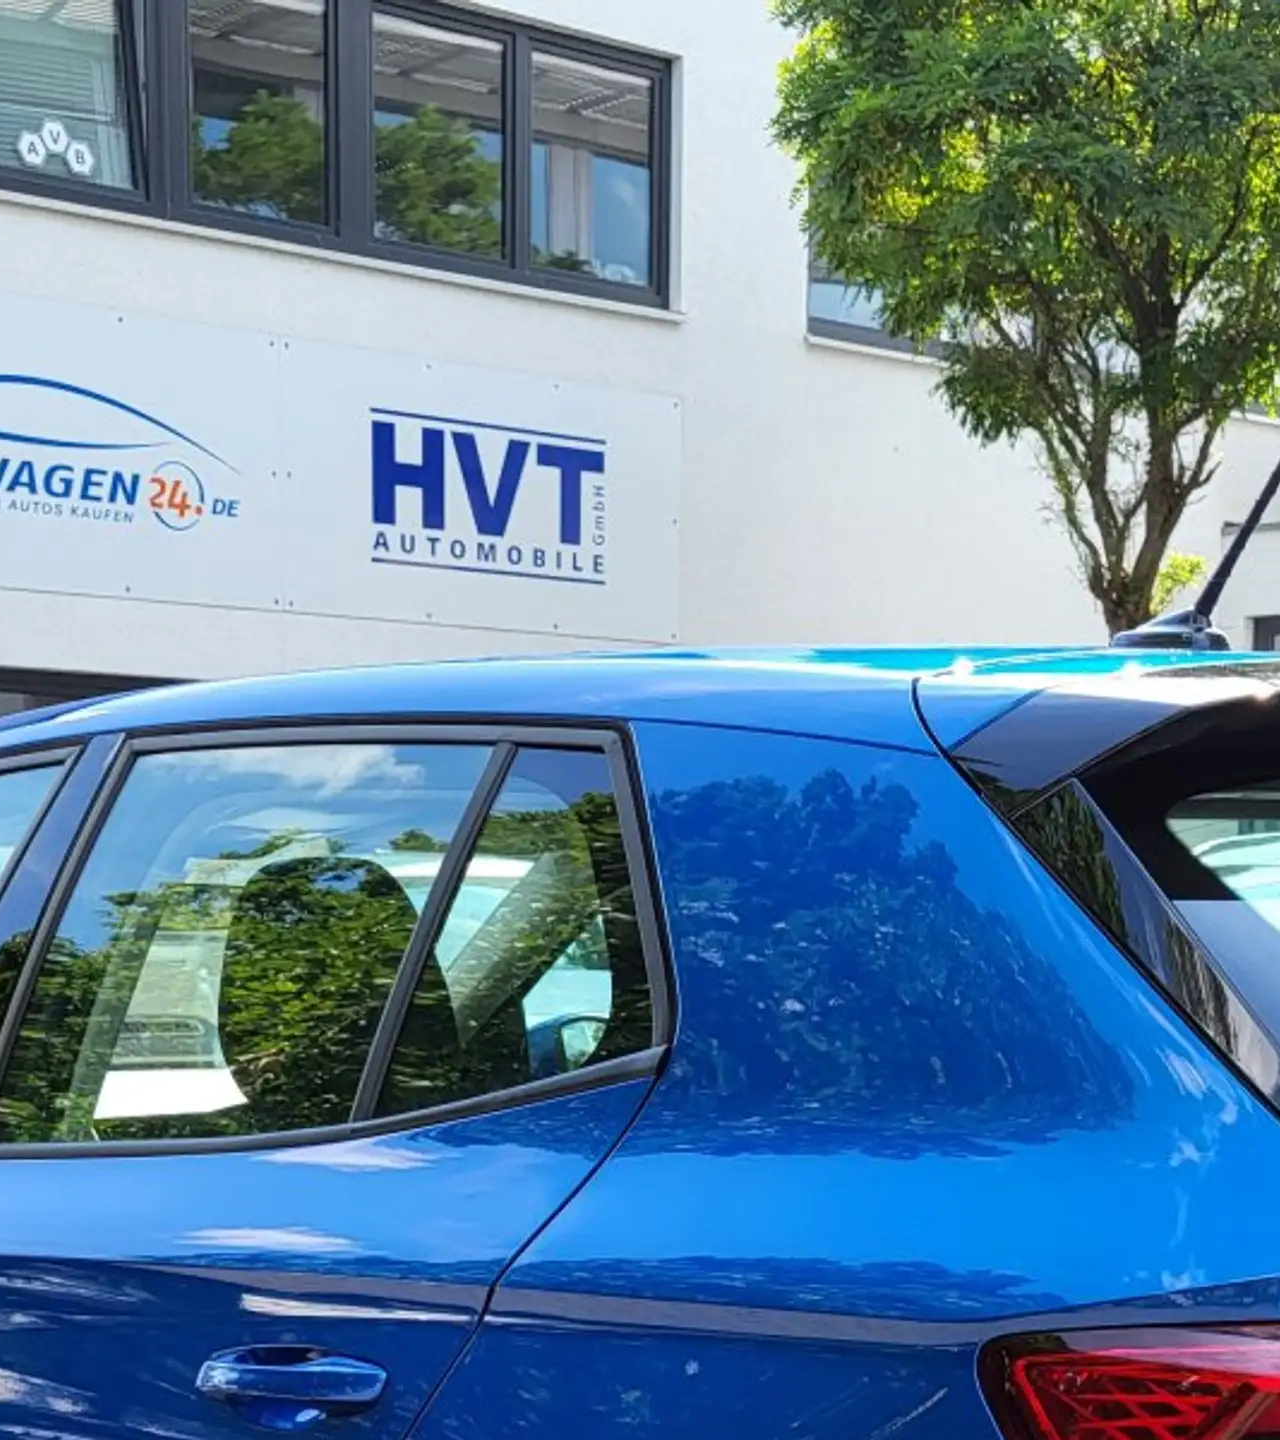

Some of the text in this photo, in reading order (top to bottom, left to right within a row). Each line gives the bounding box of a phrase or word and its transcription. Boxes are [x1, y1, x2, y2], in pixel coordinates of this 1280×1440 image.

[371, 419, 606, 546] HVT
[7, 499, 63, 517] AUTOS
[70, 505, 135, 524] KAUFEN
[591, 484, 607, 546] GmbH
[372, 530, 606, 575] AUTOMOBILE
